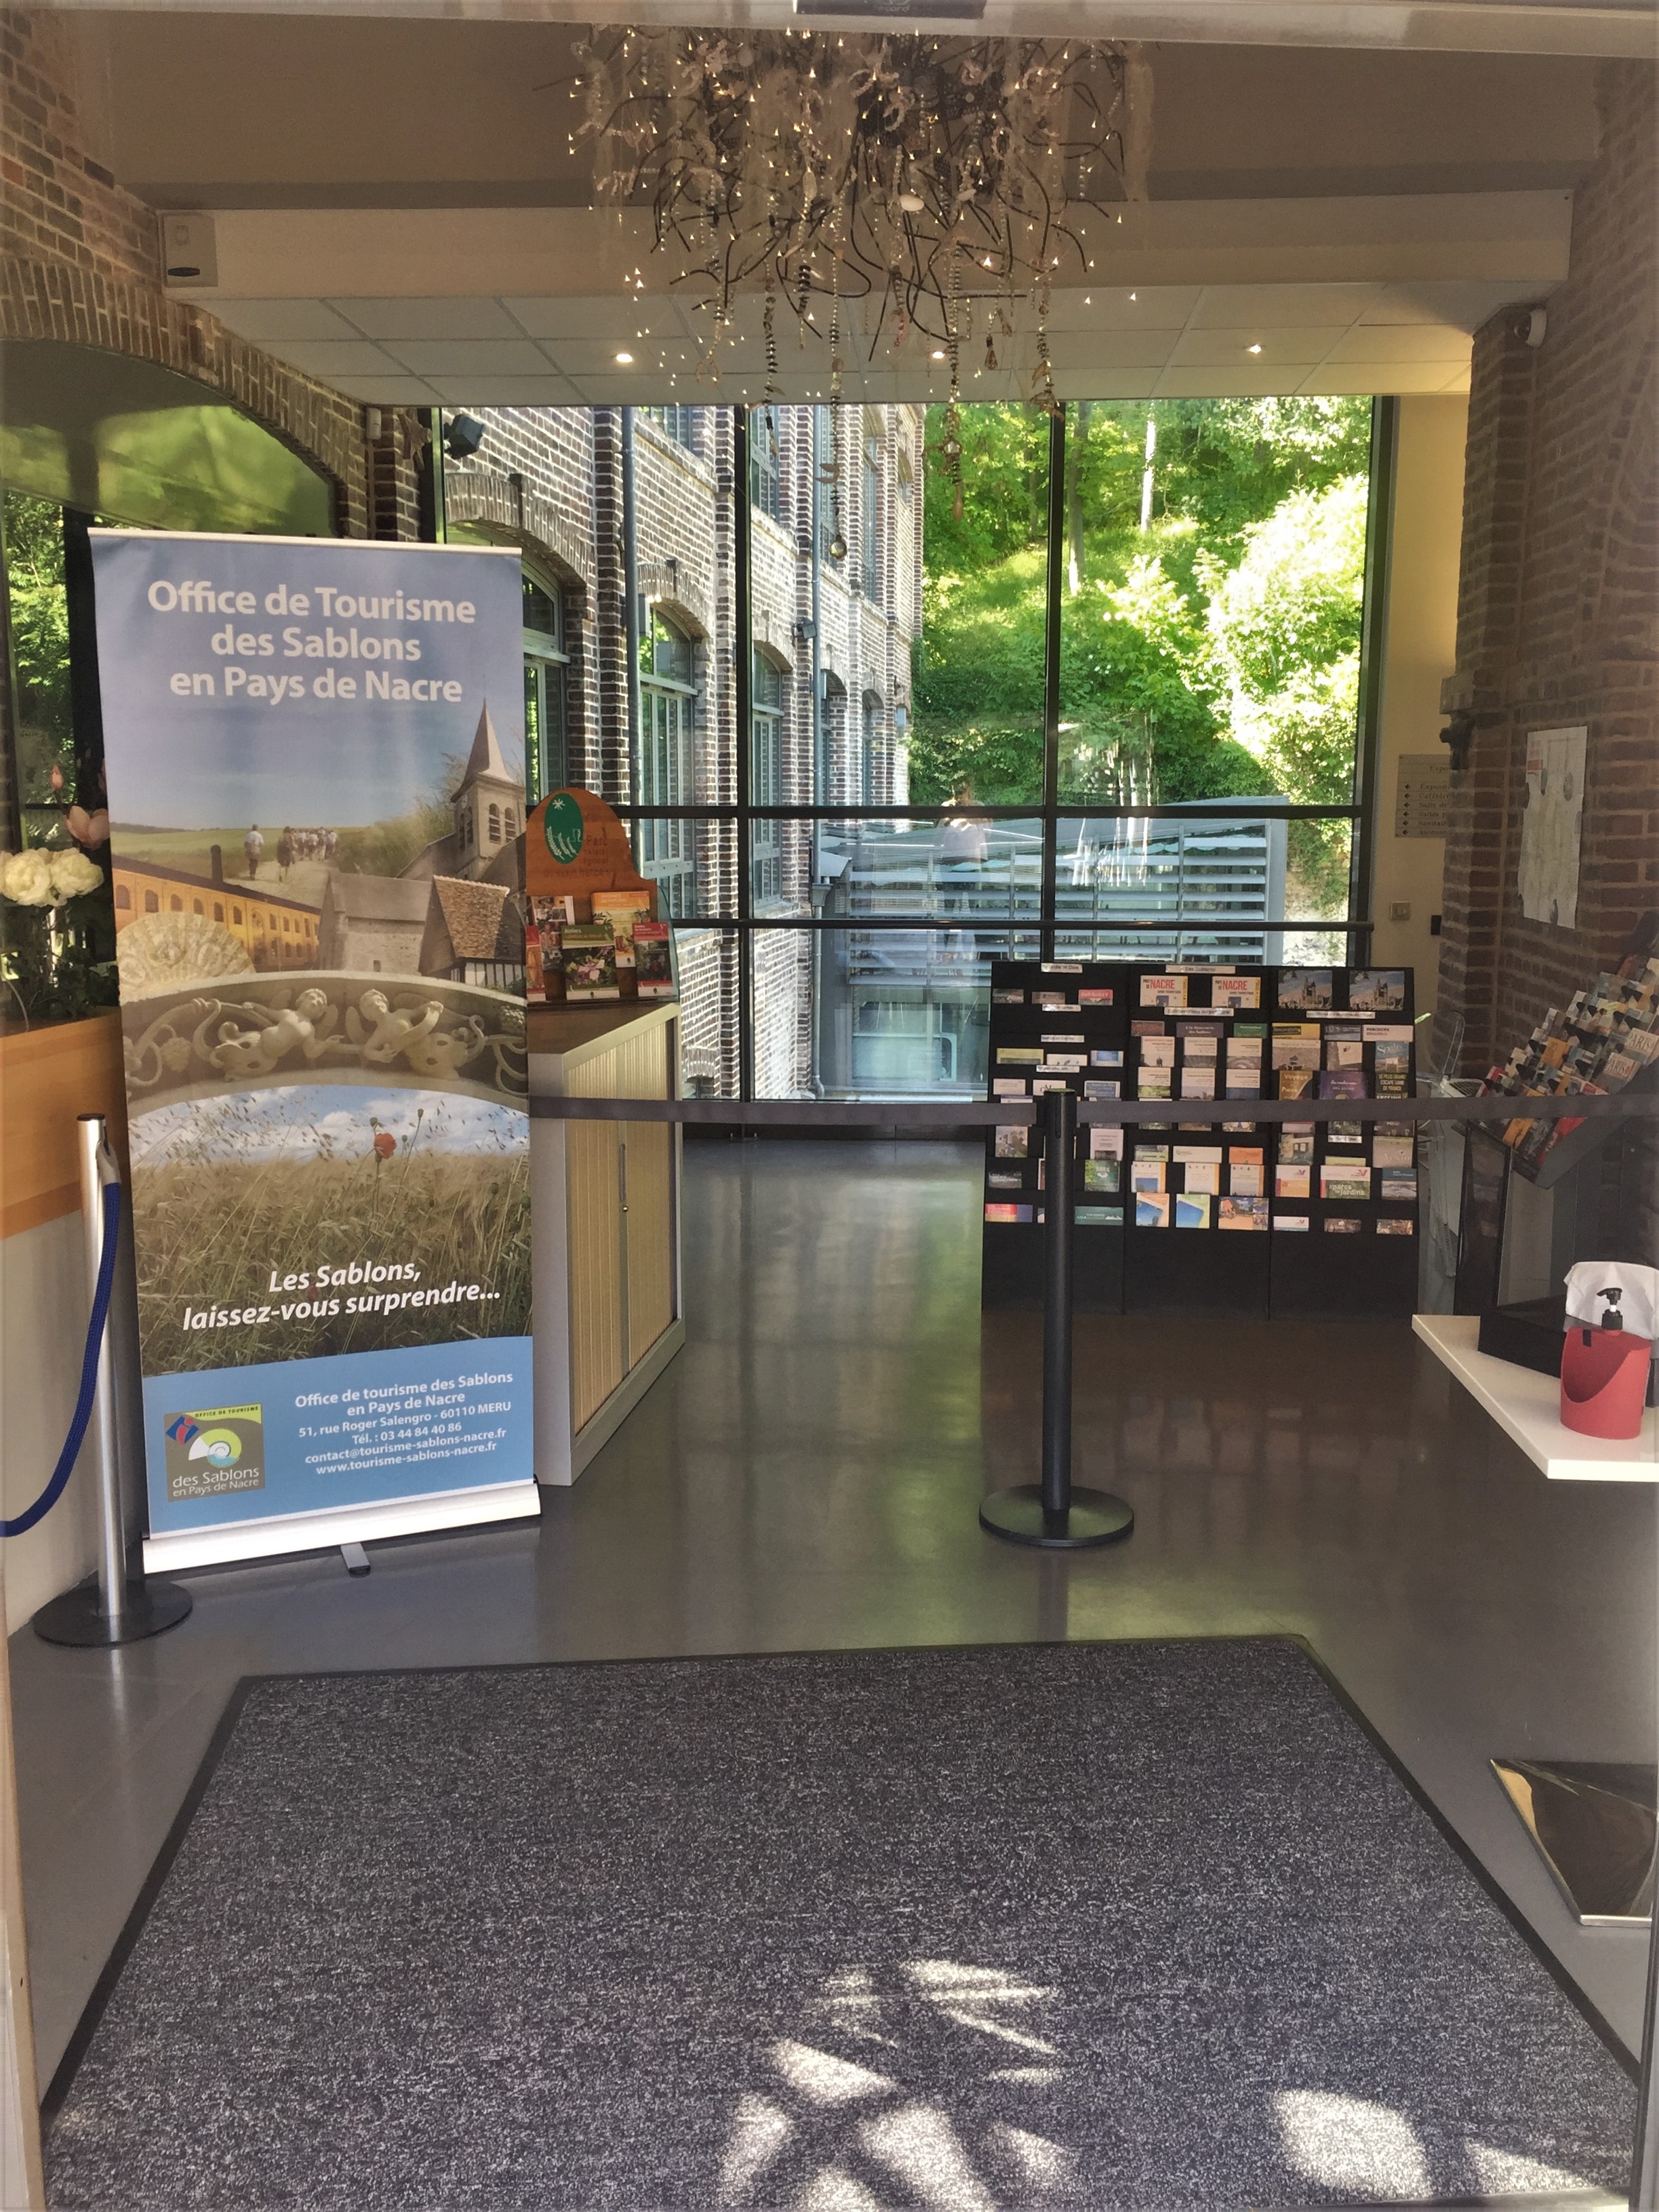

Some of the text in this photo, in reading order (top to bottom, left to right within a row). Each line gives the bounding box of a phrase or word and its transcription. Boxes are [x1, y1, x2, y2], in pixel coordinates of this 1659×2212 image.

[148, 580, 476, 624] Office de Tourisme
[212, 624, 421, 661] des Sablons
[170, 667, 462, 705] en Pays de Nacre
[586, 835, 607, 846] Parc
[1150, 979, 1176, 989] NACRE
[1222, 980, 1248, 990] NACRE
[269, 1260, 421, 1292] Les Sablons,
[183, 1280, 500, 1331] laissez-vous surprendre...
[295, 1371, 513, 1408] Office de tourisme des Sablons
[347, 1392, 465, 1416] en Pays de Nacre
[228, 1405, 259, 1414] TOURISME
[299, 1427, 317, 1437] 51,
[320, 1424, 340, 1435] rue
[342, 1419, 377, 1432] Roger
[380, 1413, 431, 1429] Salengro
[440, 1405, 476, 1420] 60110
[478, 1401, 511, 1415] MERU
[305, 1428, 506, 1464] contact@tourisme-sablons-nacre.fr
[352, 1432, 372, 1445] Tél.
[380, 1430, 395, 1441] 03
[397, 1428, 412, 1439] 44
[414, 1426, 429, 1438] 84
[431, 1424, 445, 1434] 40
[447, 1422, 462, 1432] 86
[316, 1441, 498, 1475] www.tourisme-sablons-nacre.fr
[172, 1468, 260, 1488] des Sablons
[173, 1478, 260, 1497] en Pays de Nacre
